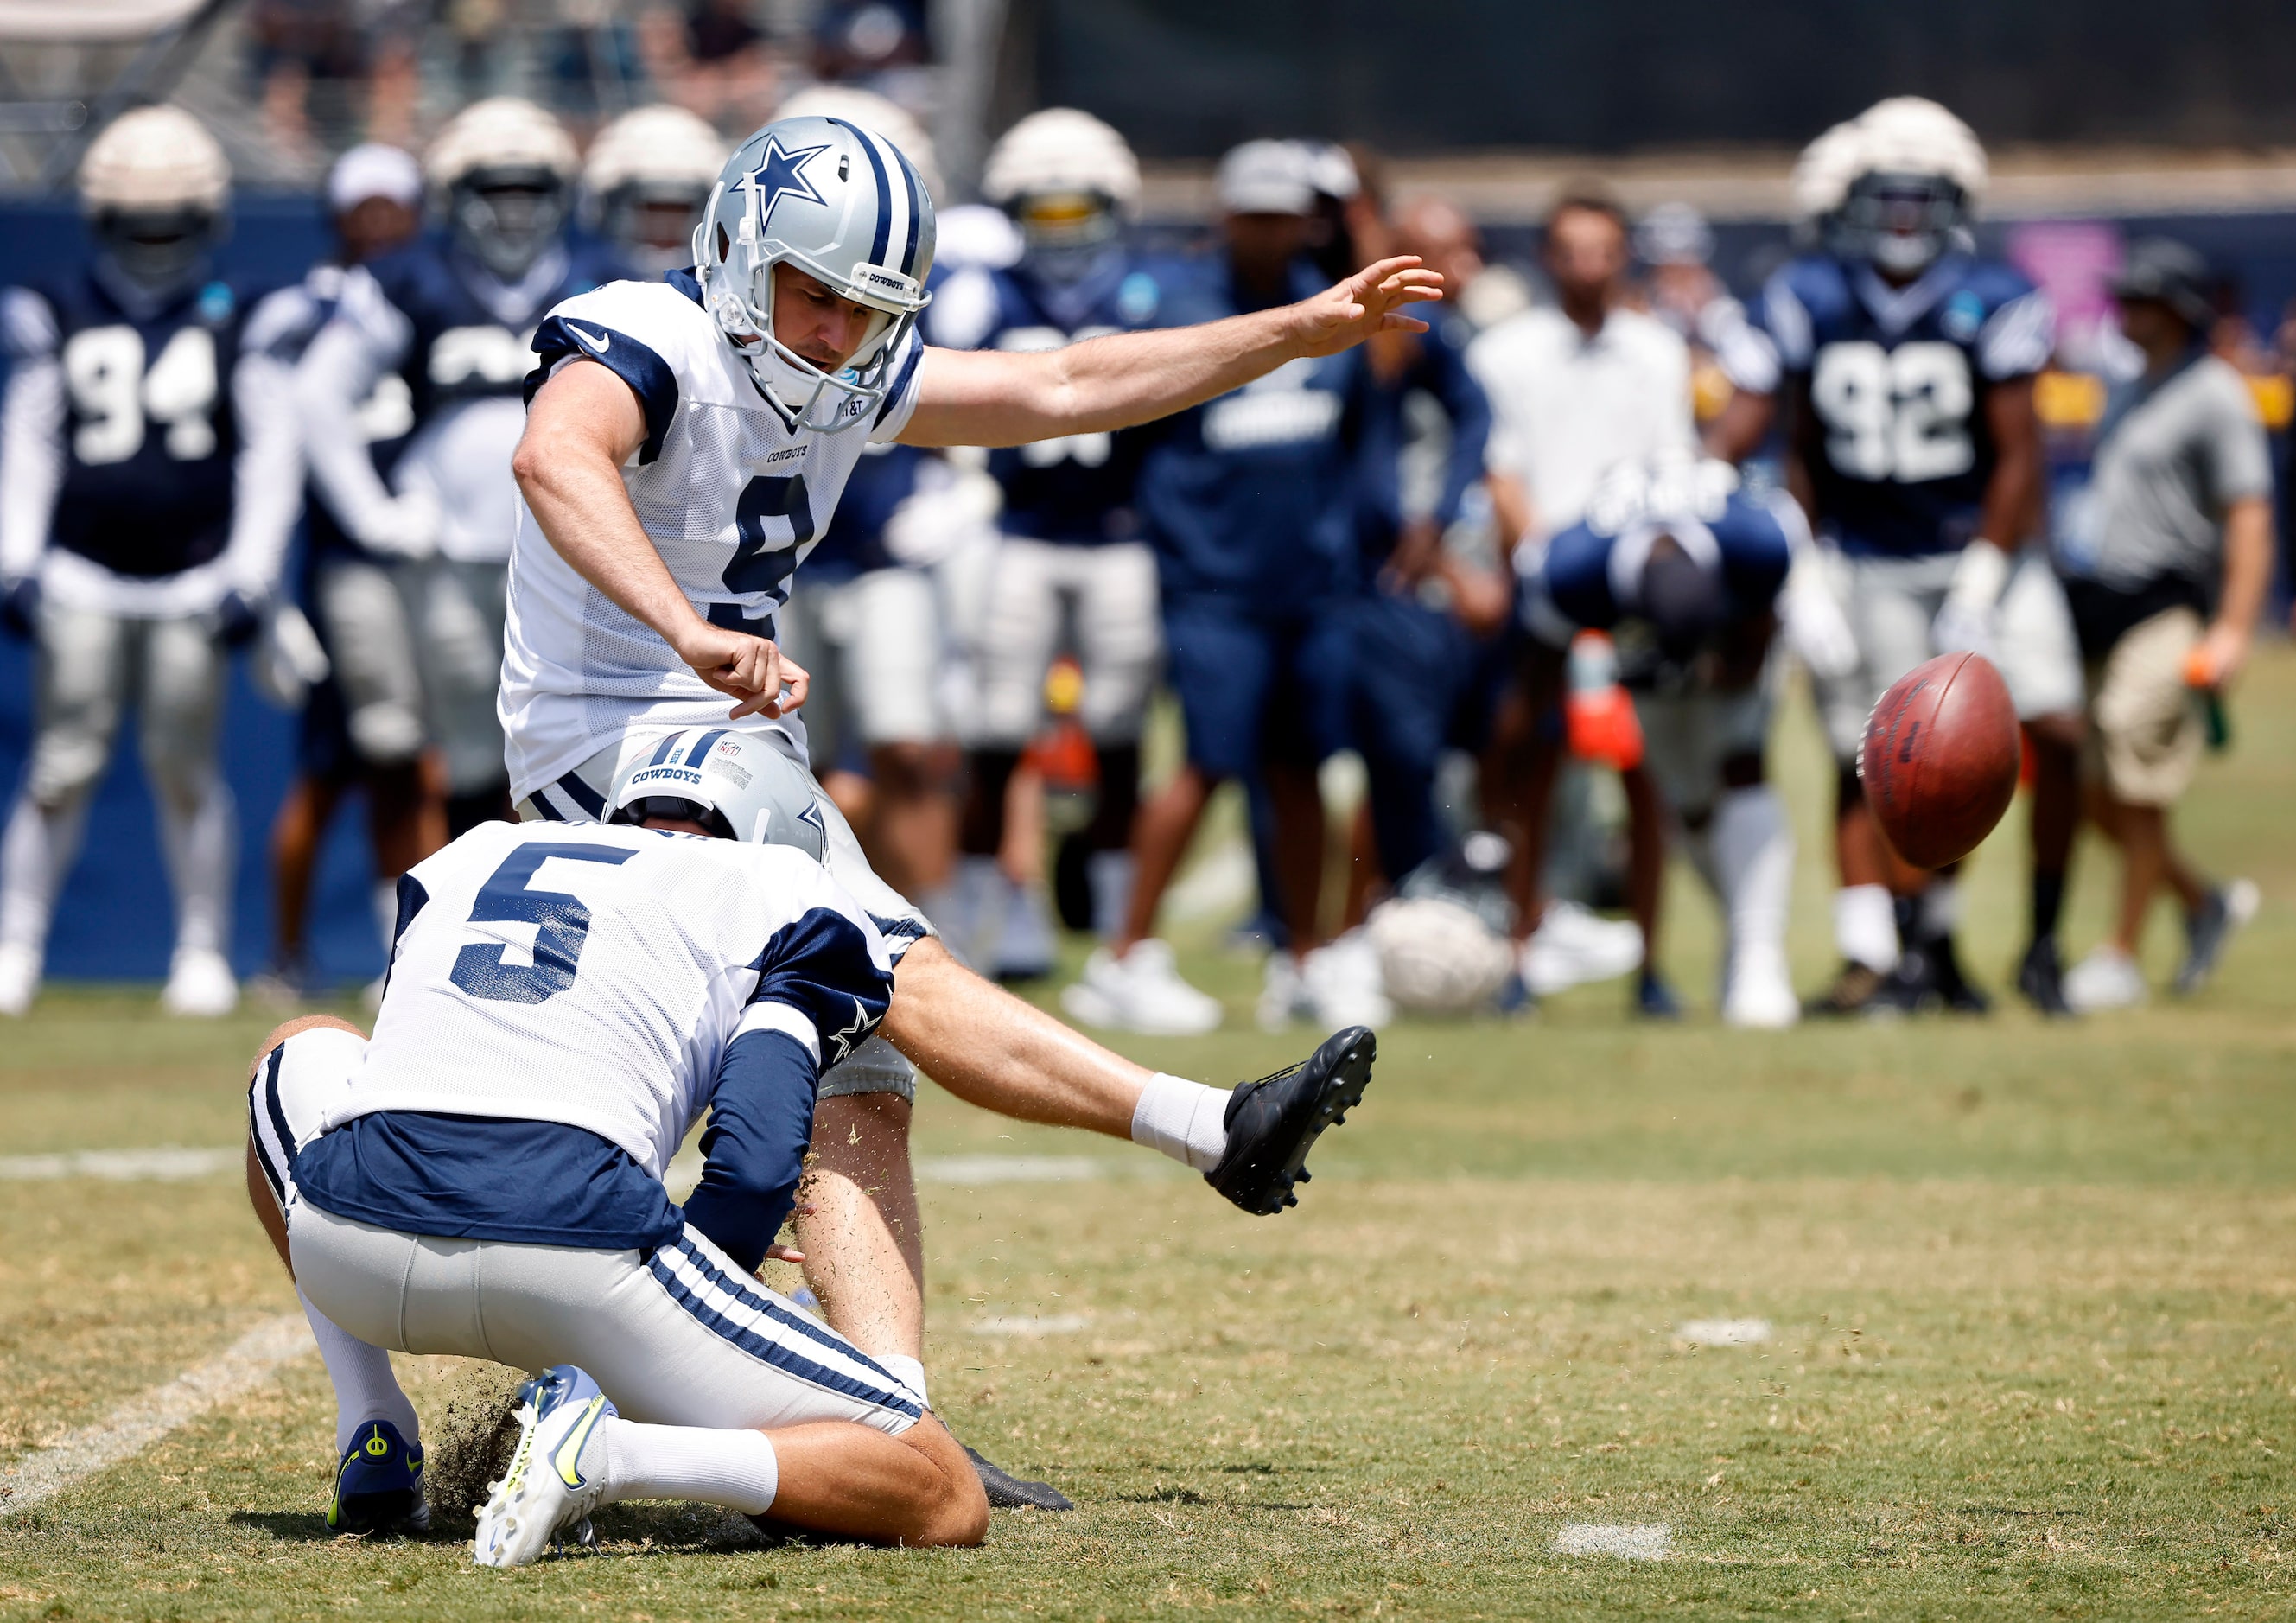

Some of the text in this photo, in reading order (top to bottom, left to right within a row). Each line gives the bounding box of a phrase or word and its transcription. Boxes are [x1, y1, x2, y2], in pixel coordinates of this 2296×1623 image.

[869, 273, 905, 290] COWBOYS
[65, 323, 218, 466] 94
[838, 400, 862, 417] T&T
[1811, 341, 1974, 482] 92
[767, 445, 808, 463] COWBOYS
[720, 745, 737, 755] NFL
[632, 768, 702, 785] COWBOYS
[449, 842, 640, 1005] 5
